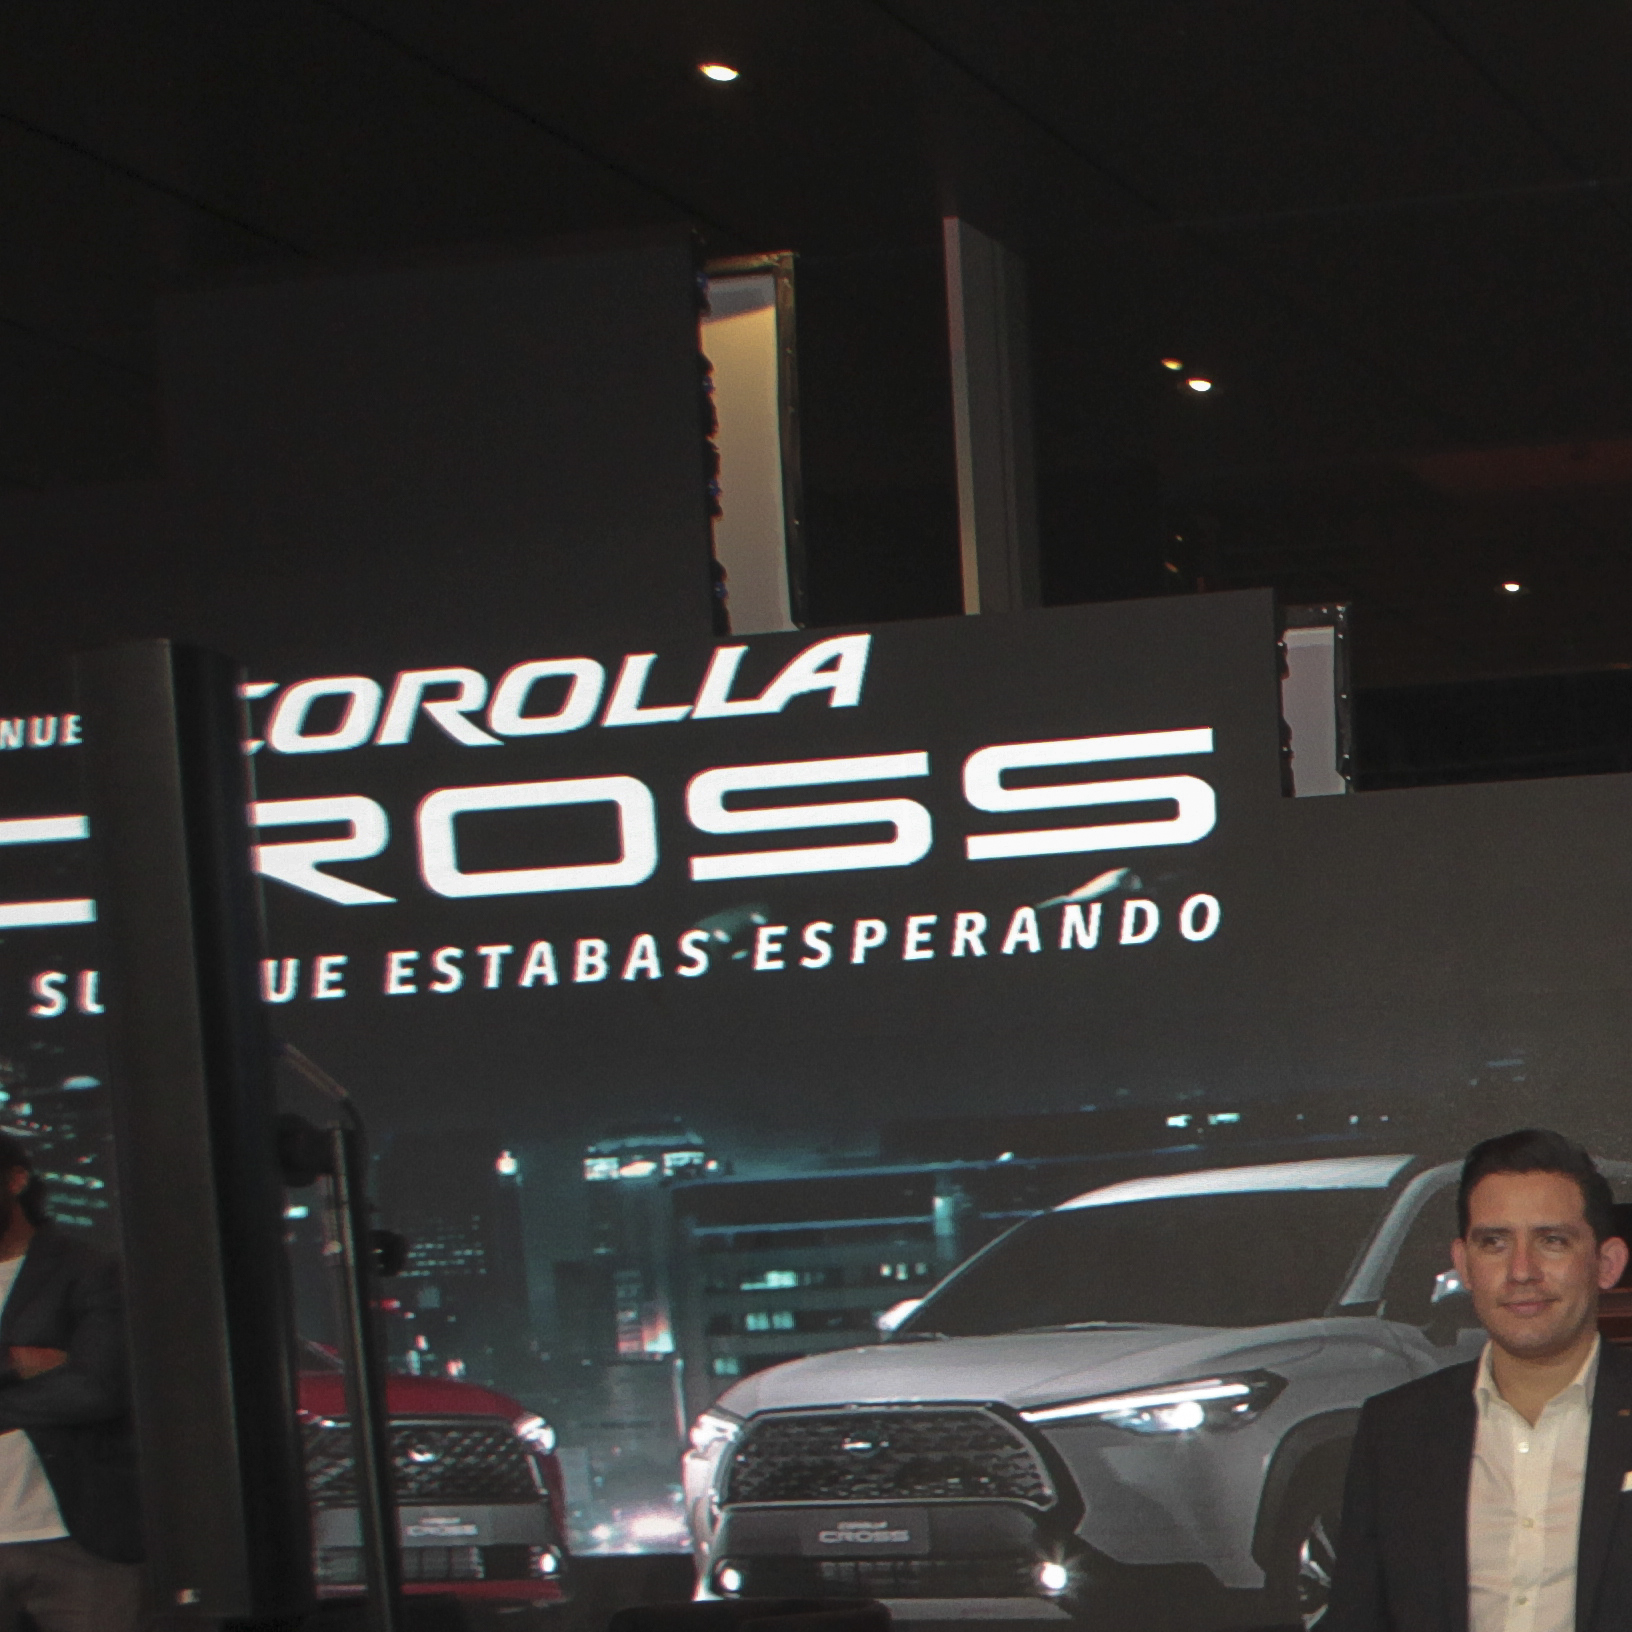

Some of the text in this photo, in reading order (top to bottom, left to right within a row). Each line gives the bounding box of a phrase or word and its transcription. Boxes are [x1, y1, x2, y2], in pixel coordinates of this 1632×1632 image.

[260, 955, 350, 1004] UE
[384, 929, 711, 996] ESTABAS
[752, 892, 1221, 972] ESPERANDO
